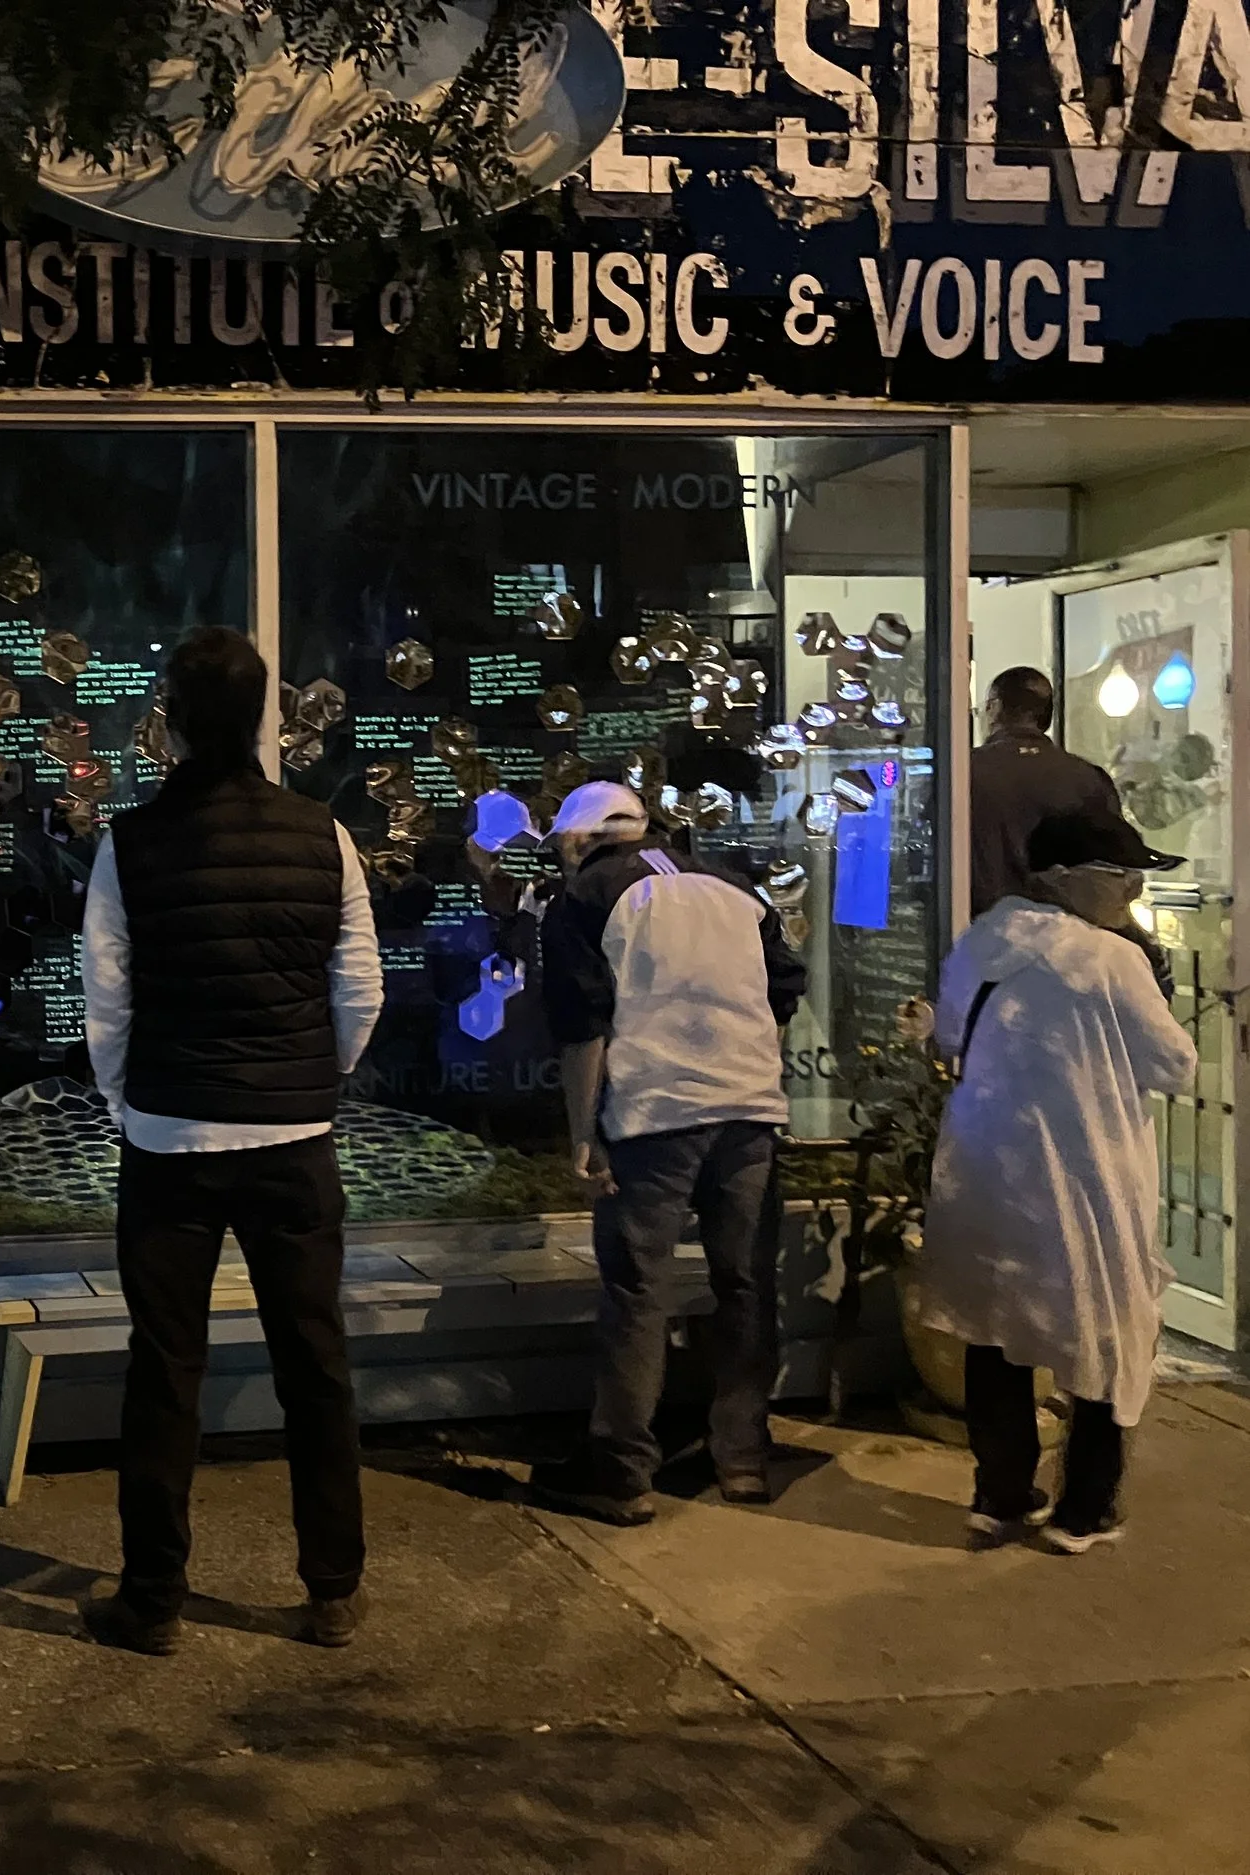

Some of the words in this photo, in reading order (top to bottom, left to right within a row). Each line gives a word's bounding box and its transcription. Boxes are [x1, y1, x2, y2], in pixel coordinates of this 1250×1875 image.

[784, 273, 836, 346] &
[860, 256, 1106, 364] VOICE
[412, 472, 598, 509] VINTAGE
[633, 474, 818, 509] MODERN
